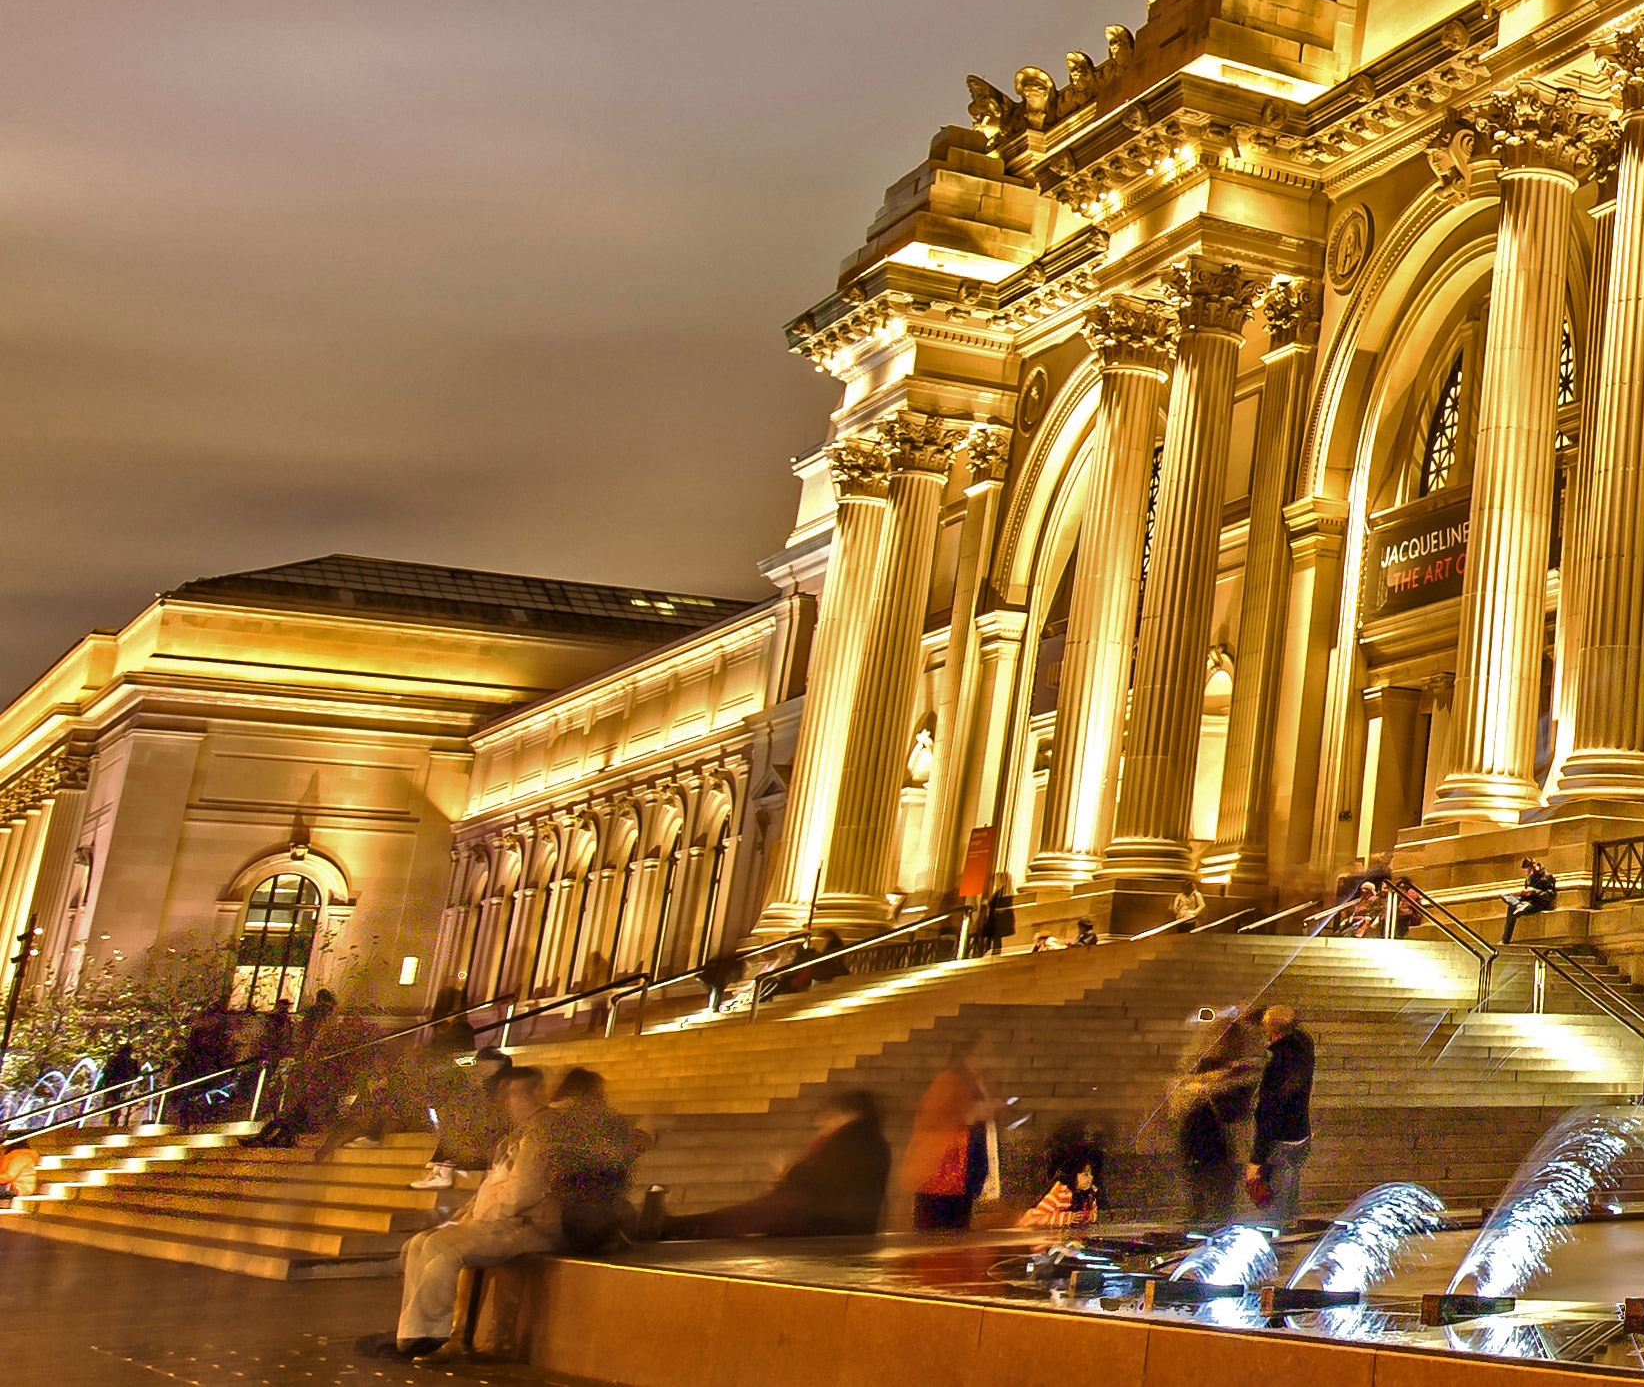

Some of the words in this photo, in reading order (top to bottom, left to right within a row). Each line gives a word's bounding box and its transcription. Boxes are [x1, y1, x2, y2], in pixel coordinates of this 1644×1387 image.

[1381, 520, 1470, 568] JACQUELINE
[1392, 567, 1420, 593] THE
[1423, 557, 1452, 585] ART
